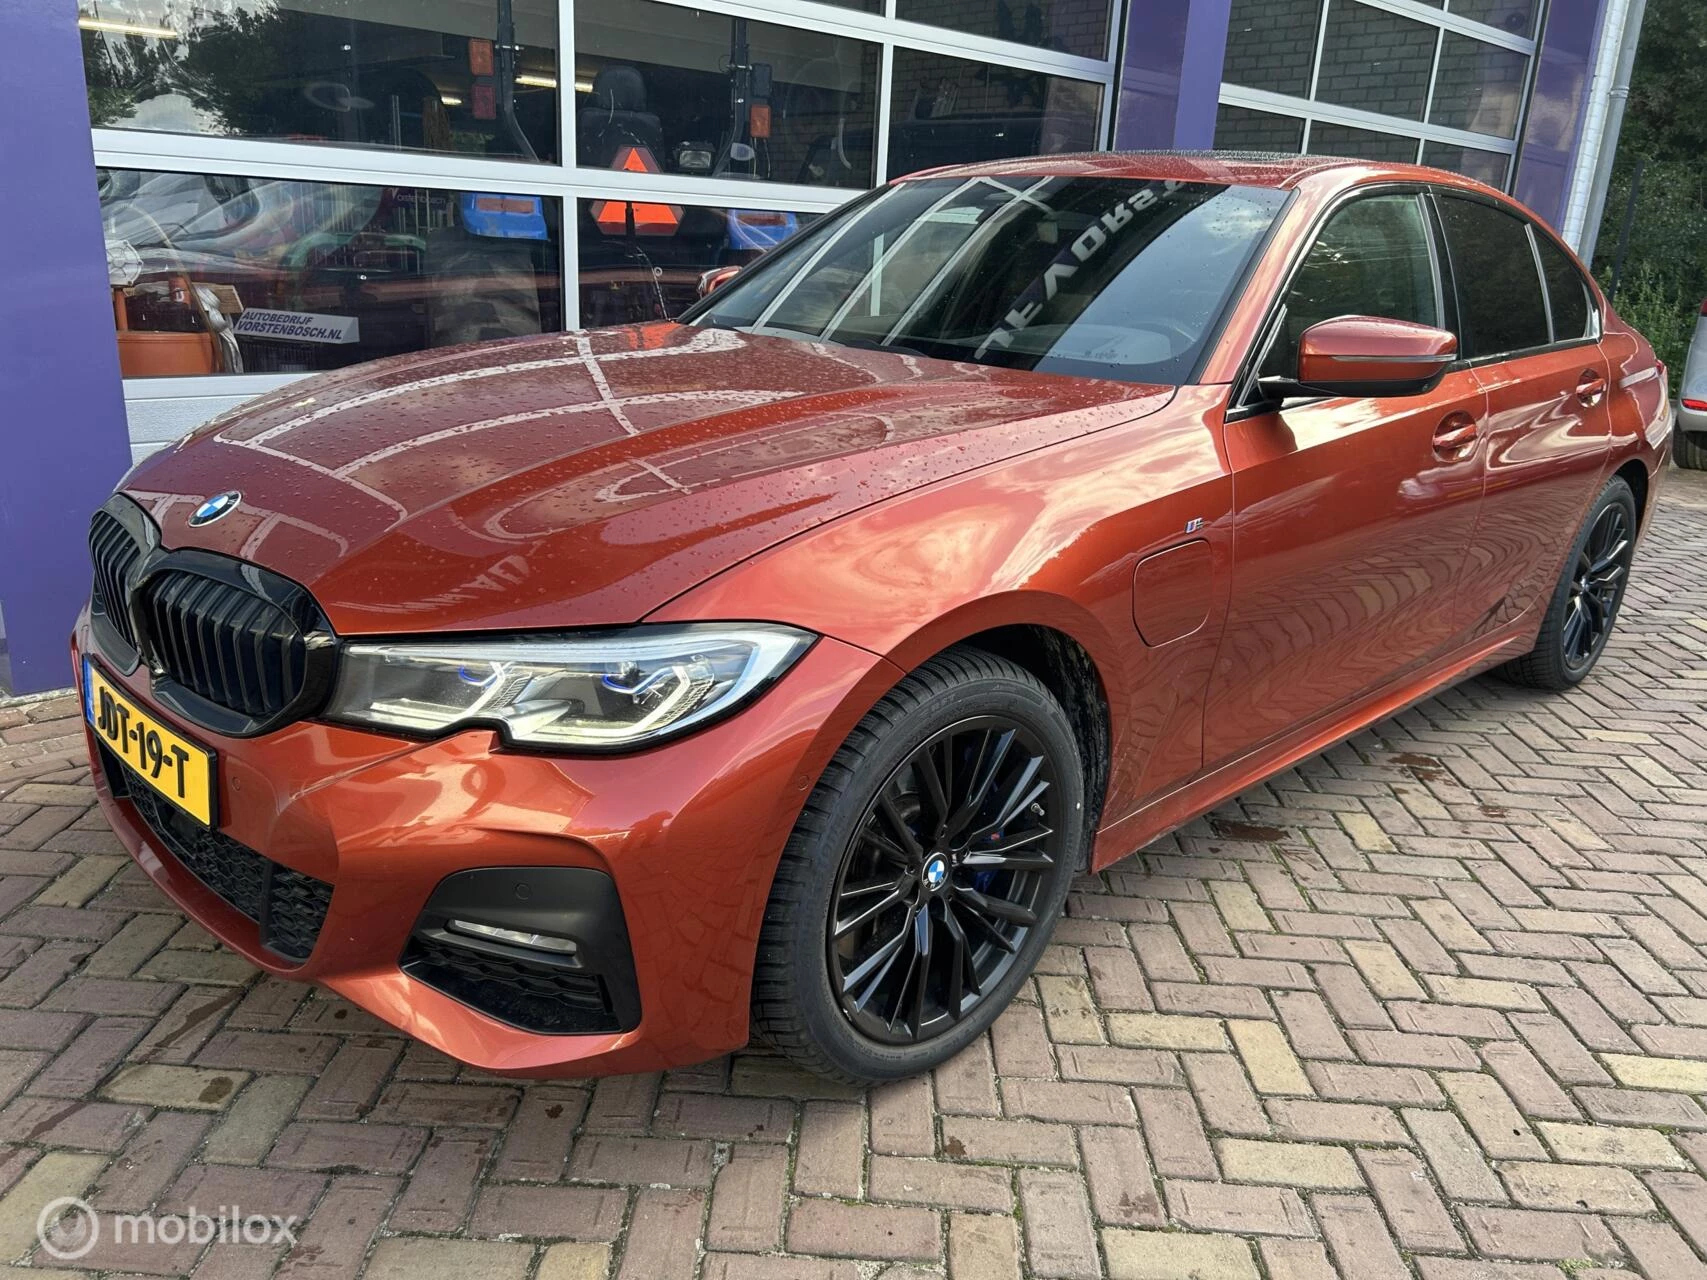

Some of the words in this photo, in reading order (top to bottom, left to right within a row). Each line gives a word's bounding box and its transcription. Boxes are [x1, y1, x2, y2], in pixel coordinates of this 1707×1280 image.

[242, 311, 314, 325] AUTOBEDRIJF
[237, 321, 343, 340] VORSTENBOSCH.NL
[98, 686, 189, 799] JDT-19-T
